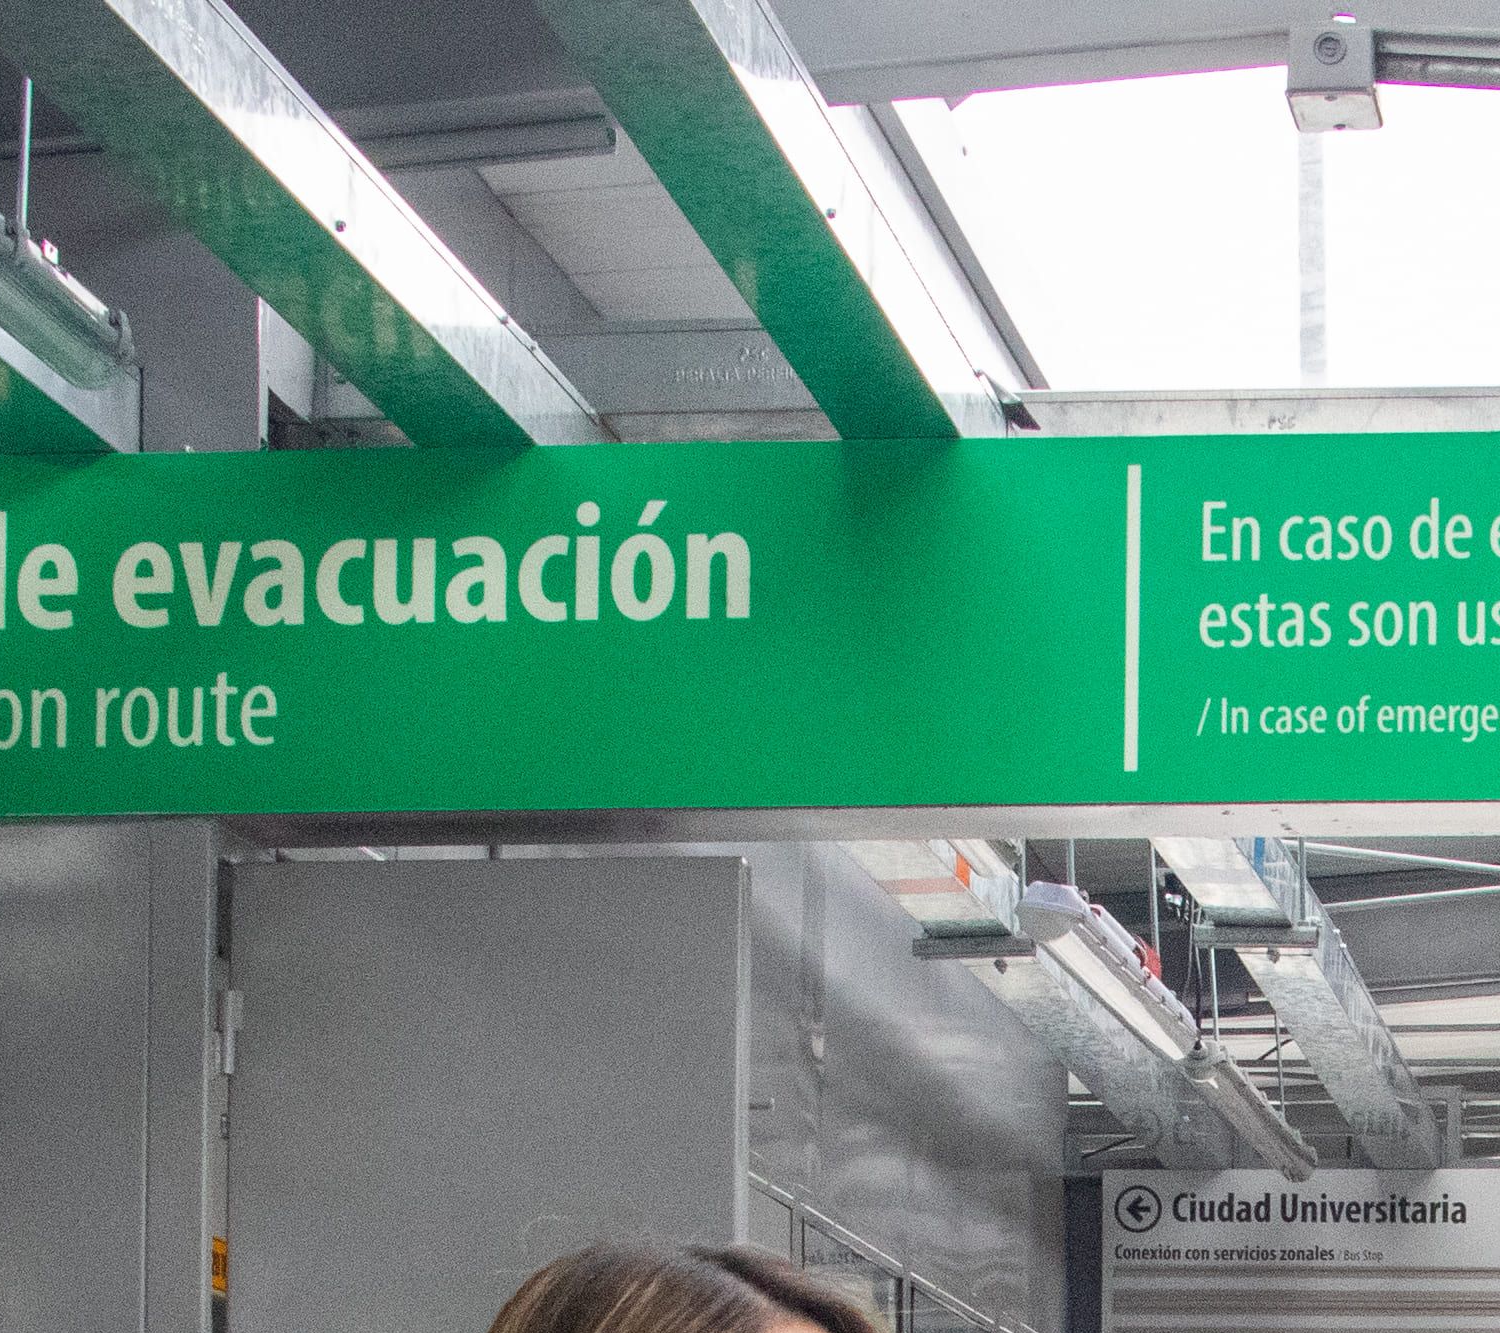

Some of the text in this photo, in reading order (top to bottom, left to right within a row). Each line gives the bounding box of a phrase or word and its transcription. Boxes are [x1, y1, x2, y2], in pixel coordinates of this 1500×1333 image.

[1201, 500, 1261, 562] En
[1278, 514, 1393, 561] caso
[1409, 497, 1473, 560] de
[112, 499, 751, 628] evacuación
[1198, 593, 1332, 649] estas
[1348, 600, 1438, 647] son
[95, 671, 277, 748] route
[1220, 697, 1250, 734] In
[1259, 705, 1328, 734] case
[1336, 694, 1369, 735] of
[1171, 1192, 1466, 1224] Ciudad Universitaria
[1113, 1243, 1182, 1262] Conexión
[1184, 1248, 1210, 1262] con
[1213, 1245, 1278, 1262] servicios
[1279, 1245, 1335, 1262] zonales
